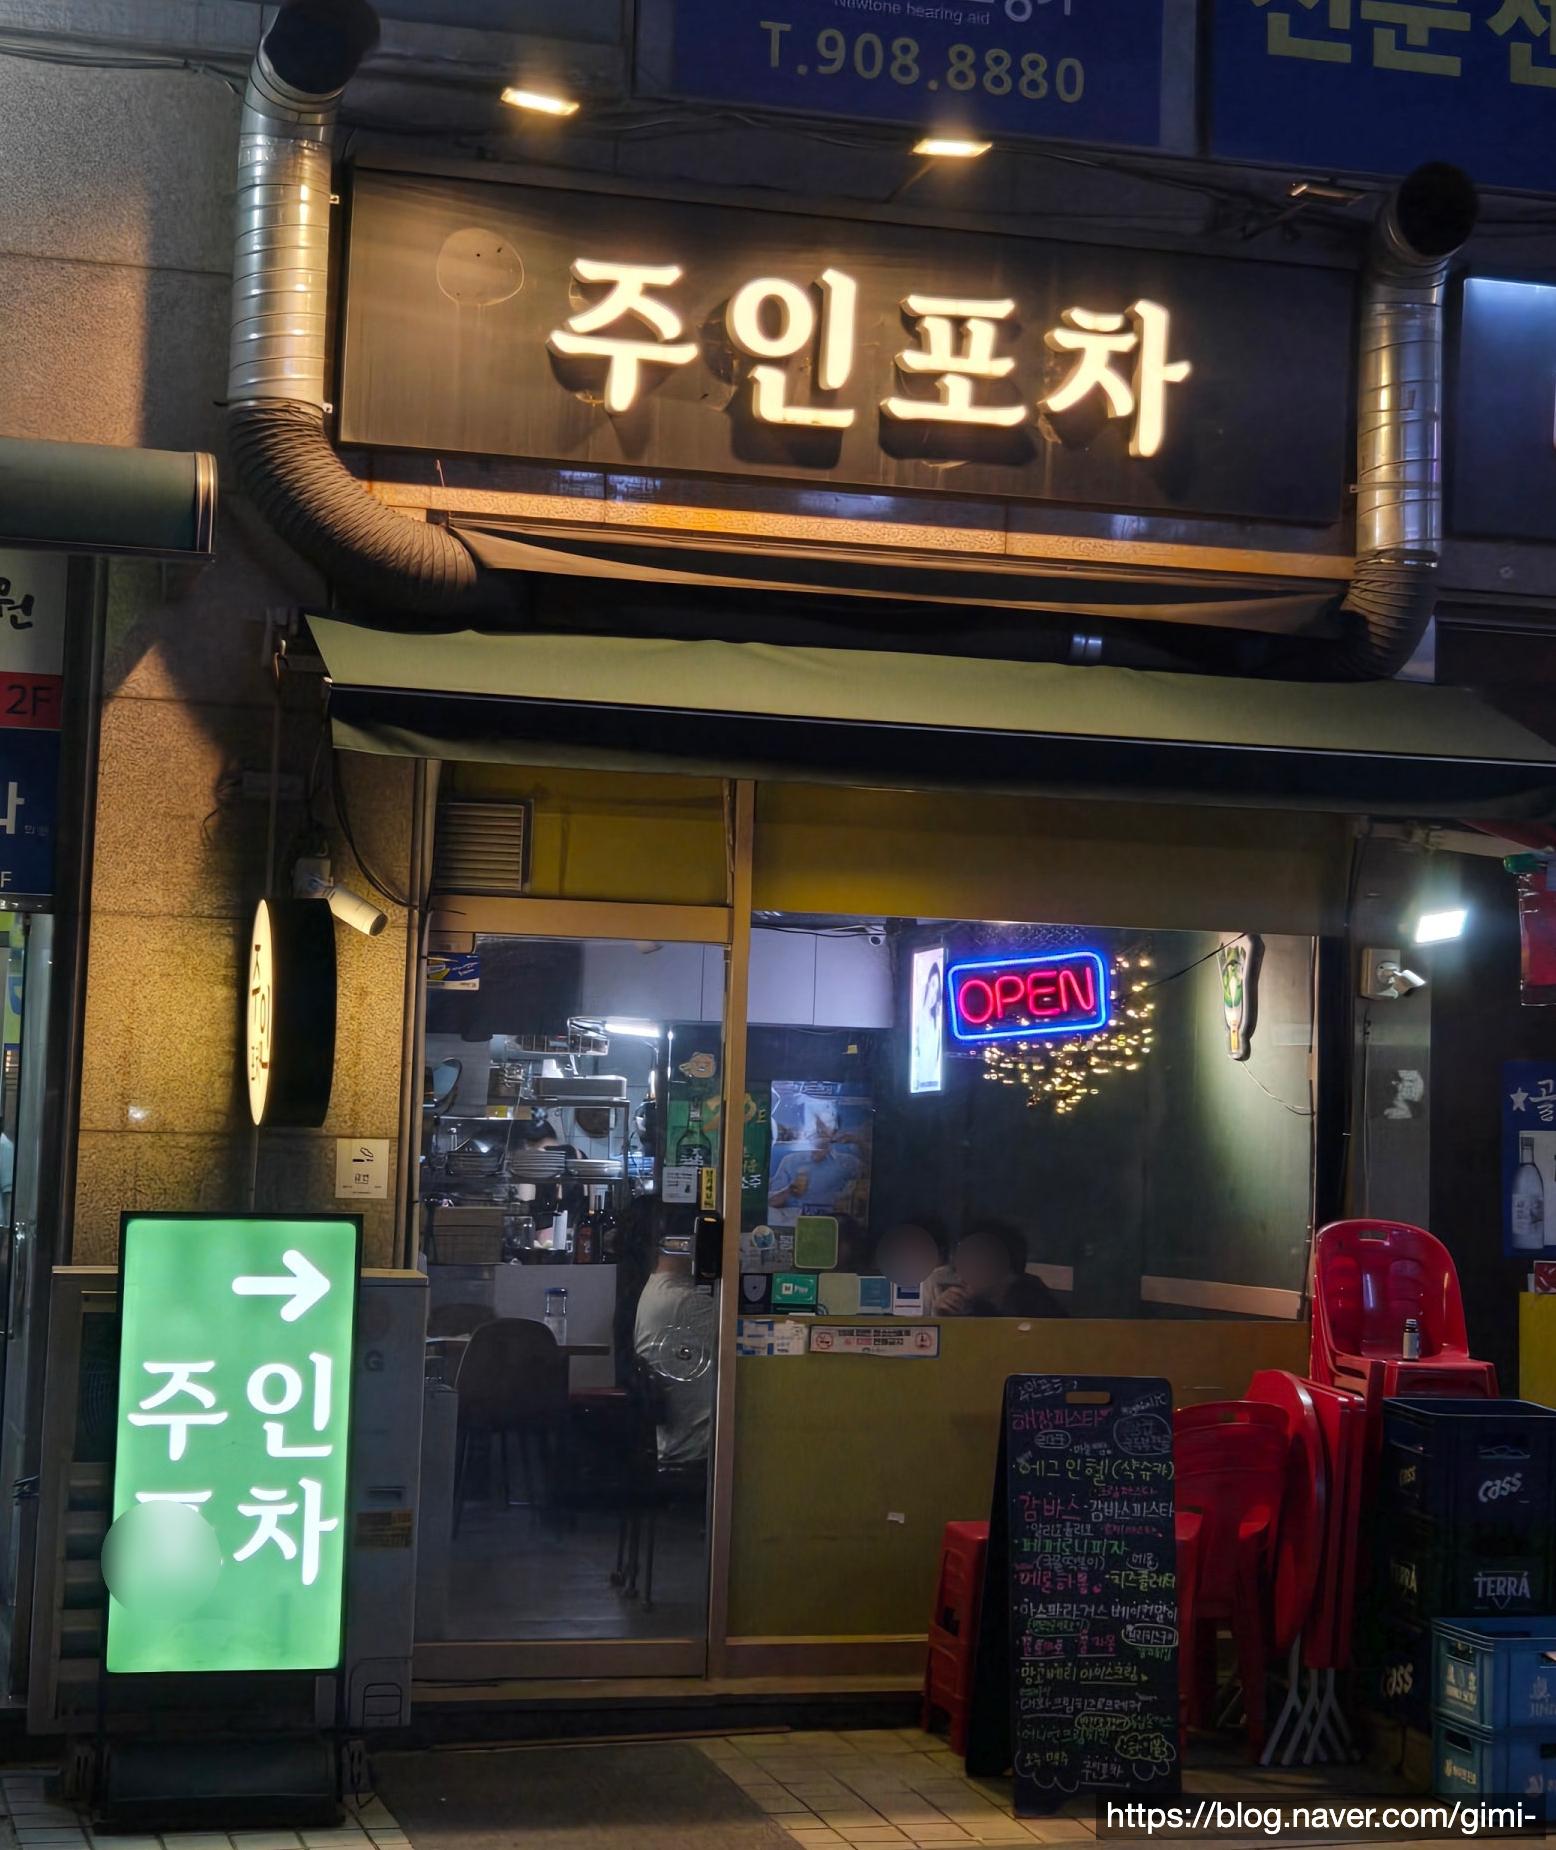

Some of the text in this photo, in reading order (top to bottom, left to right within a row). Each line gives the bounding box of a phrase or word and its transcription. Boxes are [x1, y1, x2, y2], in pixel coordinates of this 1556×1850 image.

[906, 2, 963, 25] hearing
[967, 12, 990, 25] aid
[760, 21, 1085, 103] T.908.8880
[546, 257, 1192, 458] 주인포차
[6, 684, 53, 716] 2F
[959, 966, 1096, 1023] OPEN
[127, 1352, 334, 1462] 주인
[135, 1478, 339, 1585] 차
[1017, 1495, 1081, 1522] 감바스
